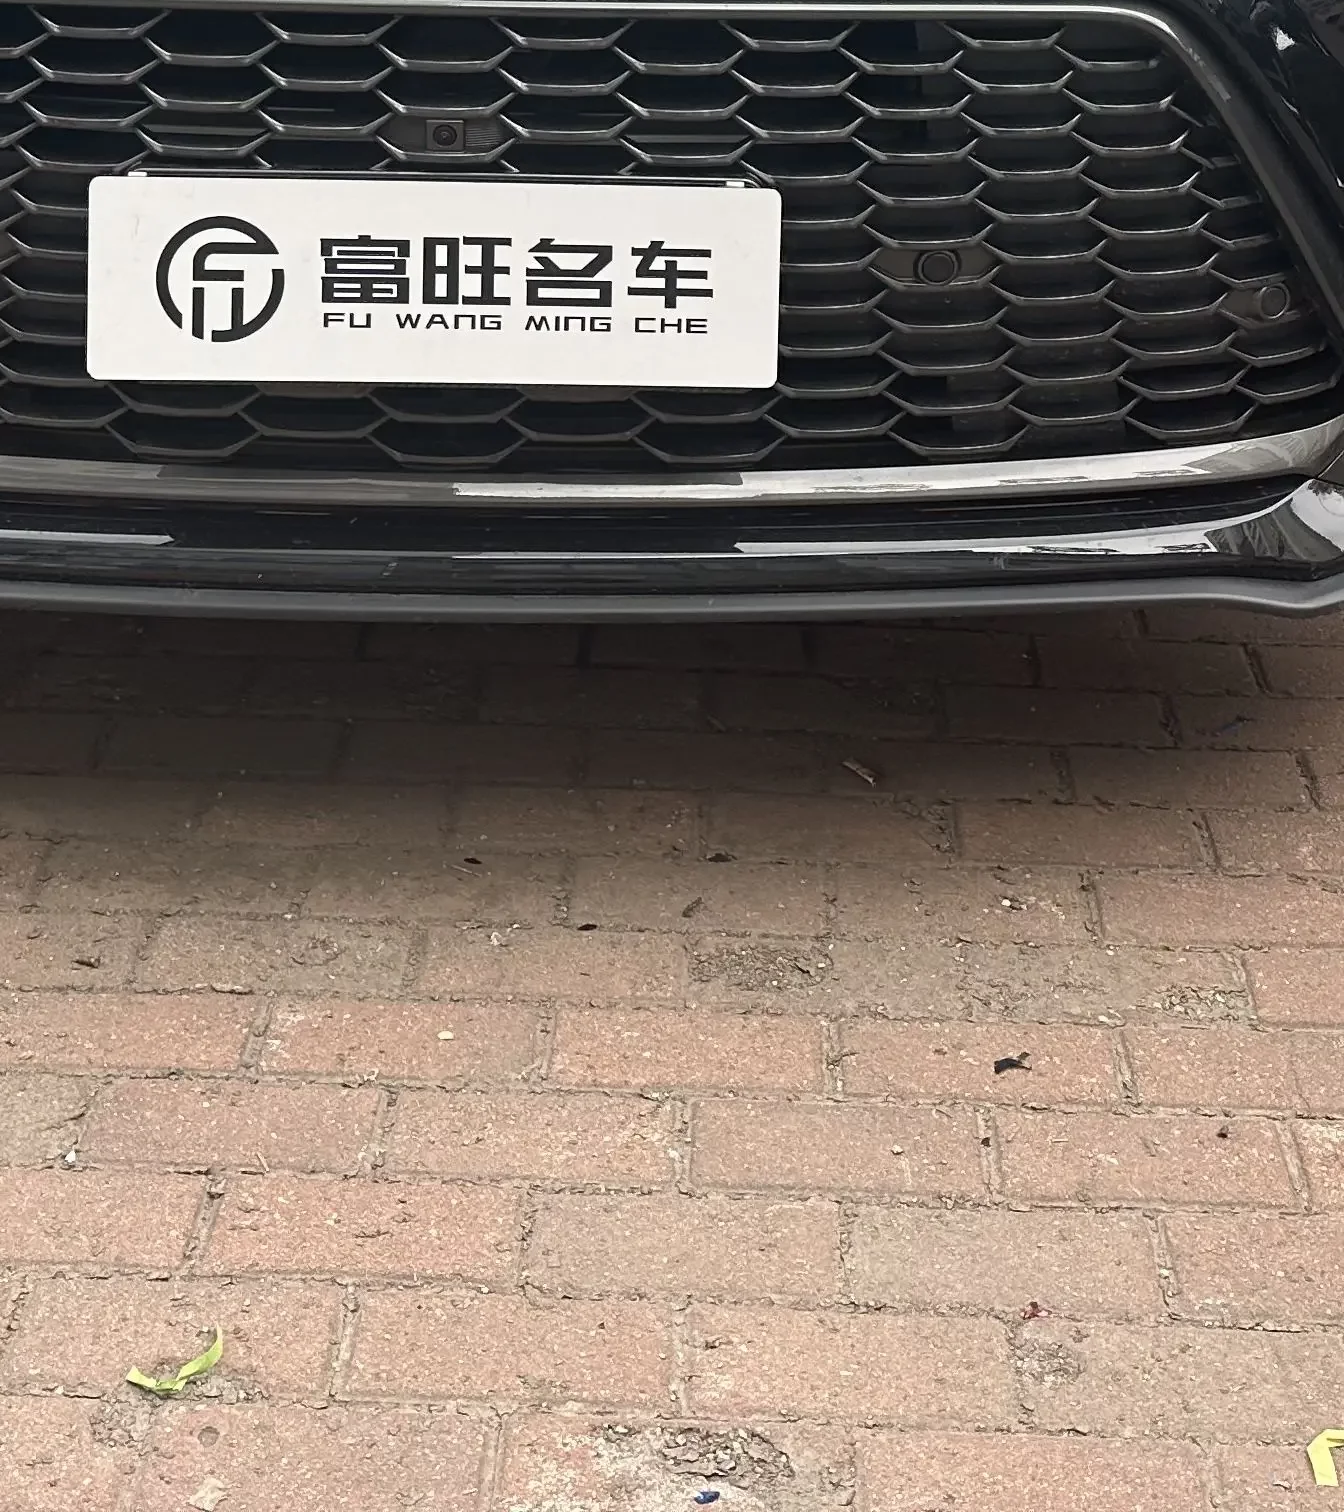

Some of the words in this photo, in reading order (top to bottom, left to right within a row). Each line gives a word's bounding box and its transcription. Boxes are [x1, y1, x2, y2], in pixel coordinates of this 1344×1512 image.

[319, 234, 714, 309] 富旺名车
[323, 312, 372, 329] FU
[395, 313, 502, 331] WANG
[524, 315, 612, 333] MING
[634, 317, 708, 334] CHE
